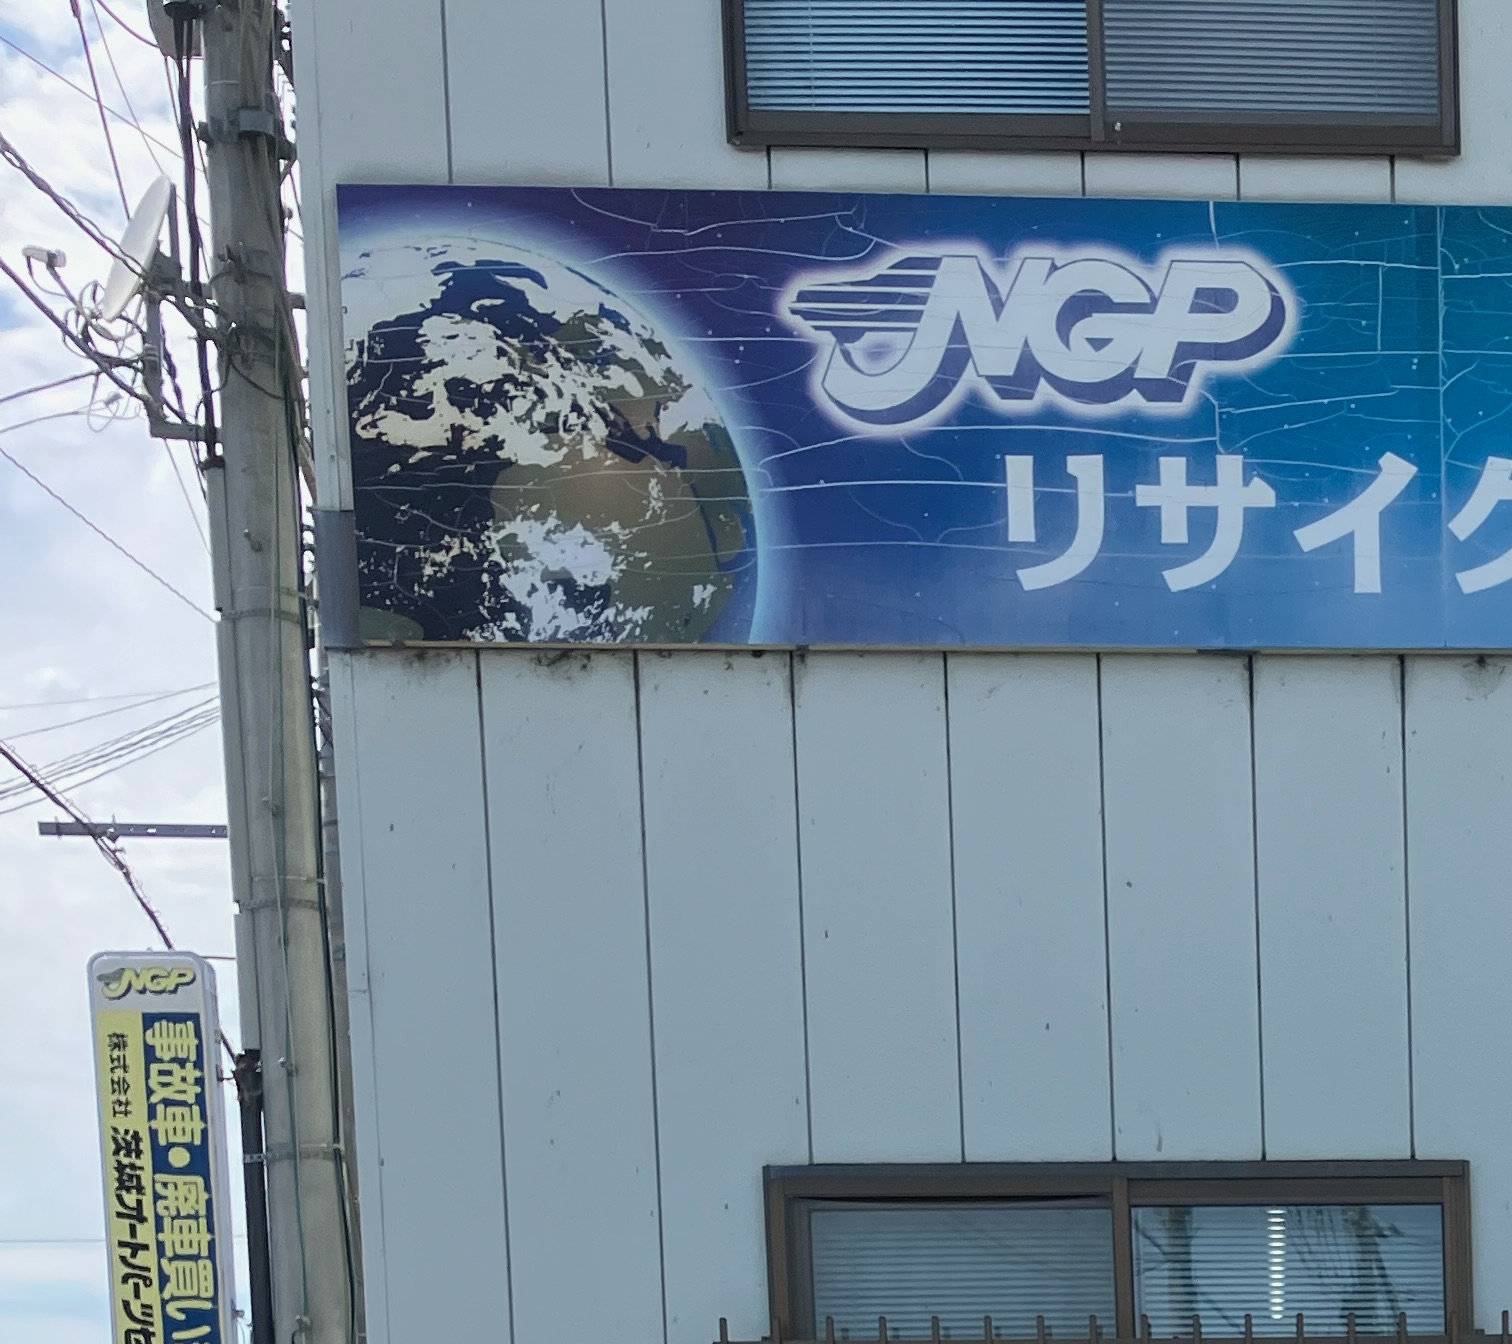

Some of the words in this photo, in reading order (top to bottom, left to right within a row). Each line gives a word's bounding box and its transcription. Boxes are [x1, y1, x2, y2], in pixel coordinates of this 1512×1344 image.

[792, 255, 1286, 425] NGP
[97, 966, 196, 1001] NGP
[107, 1032, 133, 1118] 株式会社
